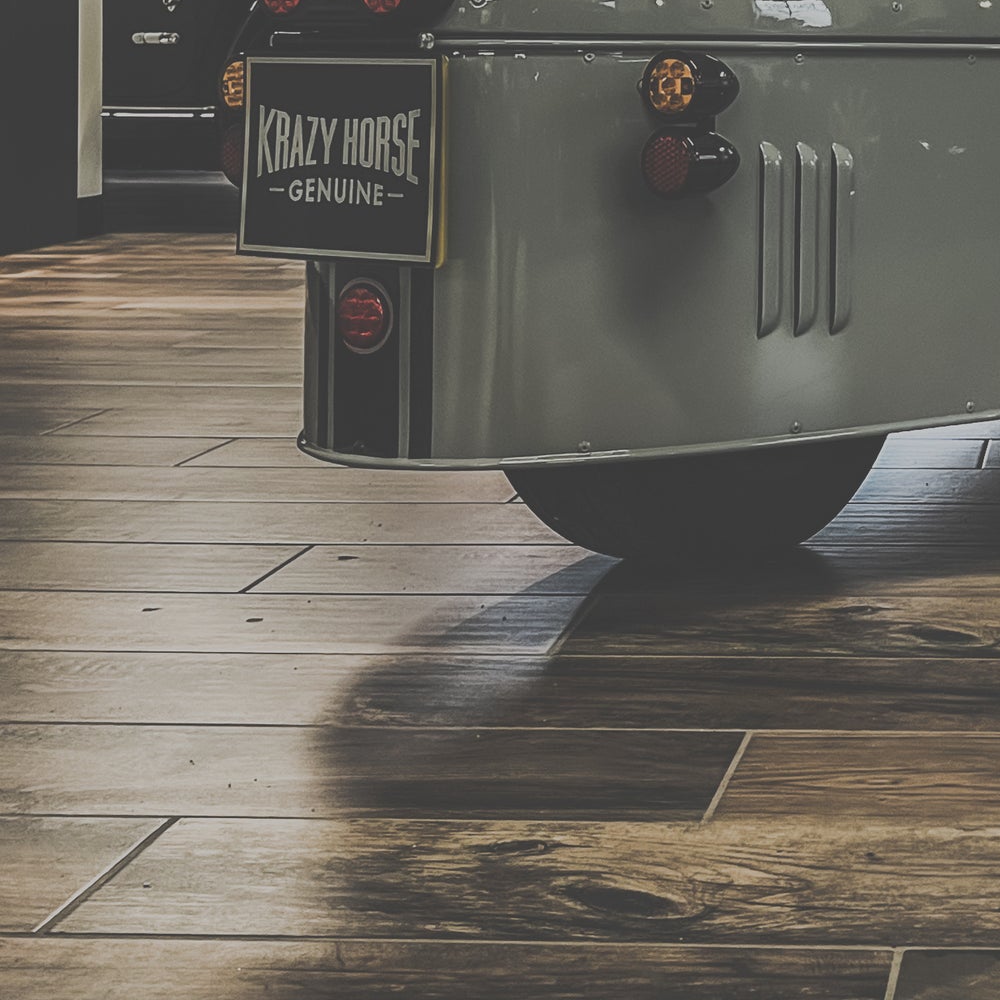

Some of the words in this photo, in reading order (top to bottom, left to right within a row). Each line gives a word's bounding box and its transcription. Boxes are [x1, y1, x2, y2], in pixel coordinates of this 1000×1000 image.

[256, 104, 338, 178] KRAZY
[342, 108, 421, 185] HORSE
[288, 177, 384, 206] GENUINE
